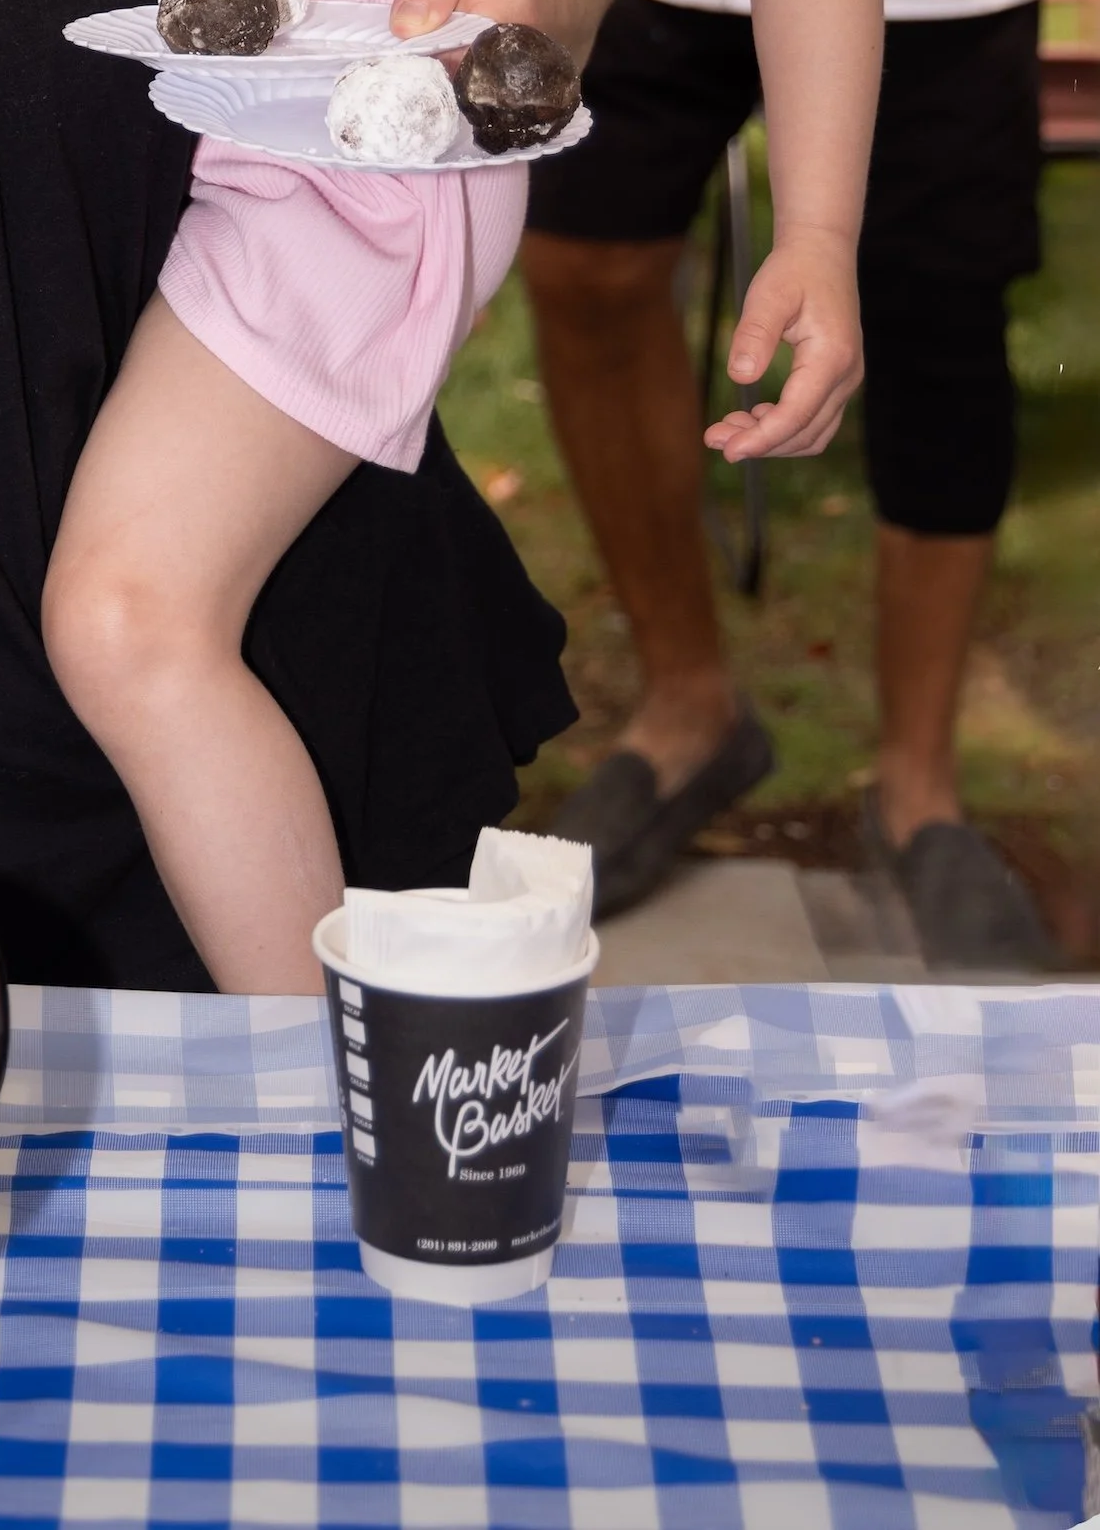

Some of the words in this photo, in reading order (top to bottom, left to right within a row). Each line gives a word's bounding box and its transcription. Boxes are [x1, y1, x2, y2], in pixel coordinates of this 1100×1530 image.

[412, 1018, 569, 1154] Market
[448, 1046, 581, 1178] Basket
[459, 1167, 494, 1181] Since
[499, 1164, 526, 1179] 1960
[417, 1238, 445, 1251] (201)
[447, 1239, 498, 1252] 891-2000
